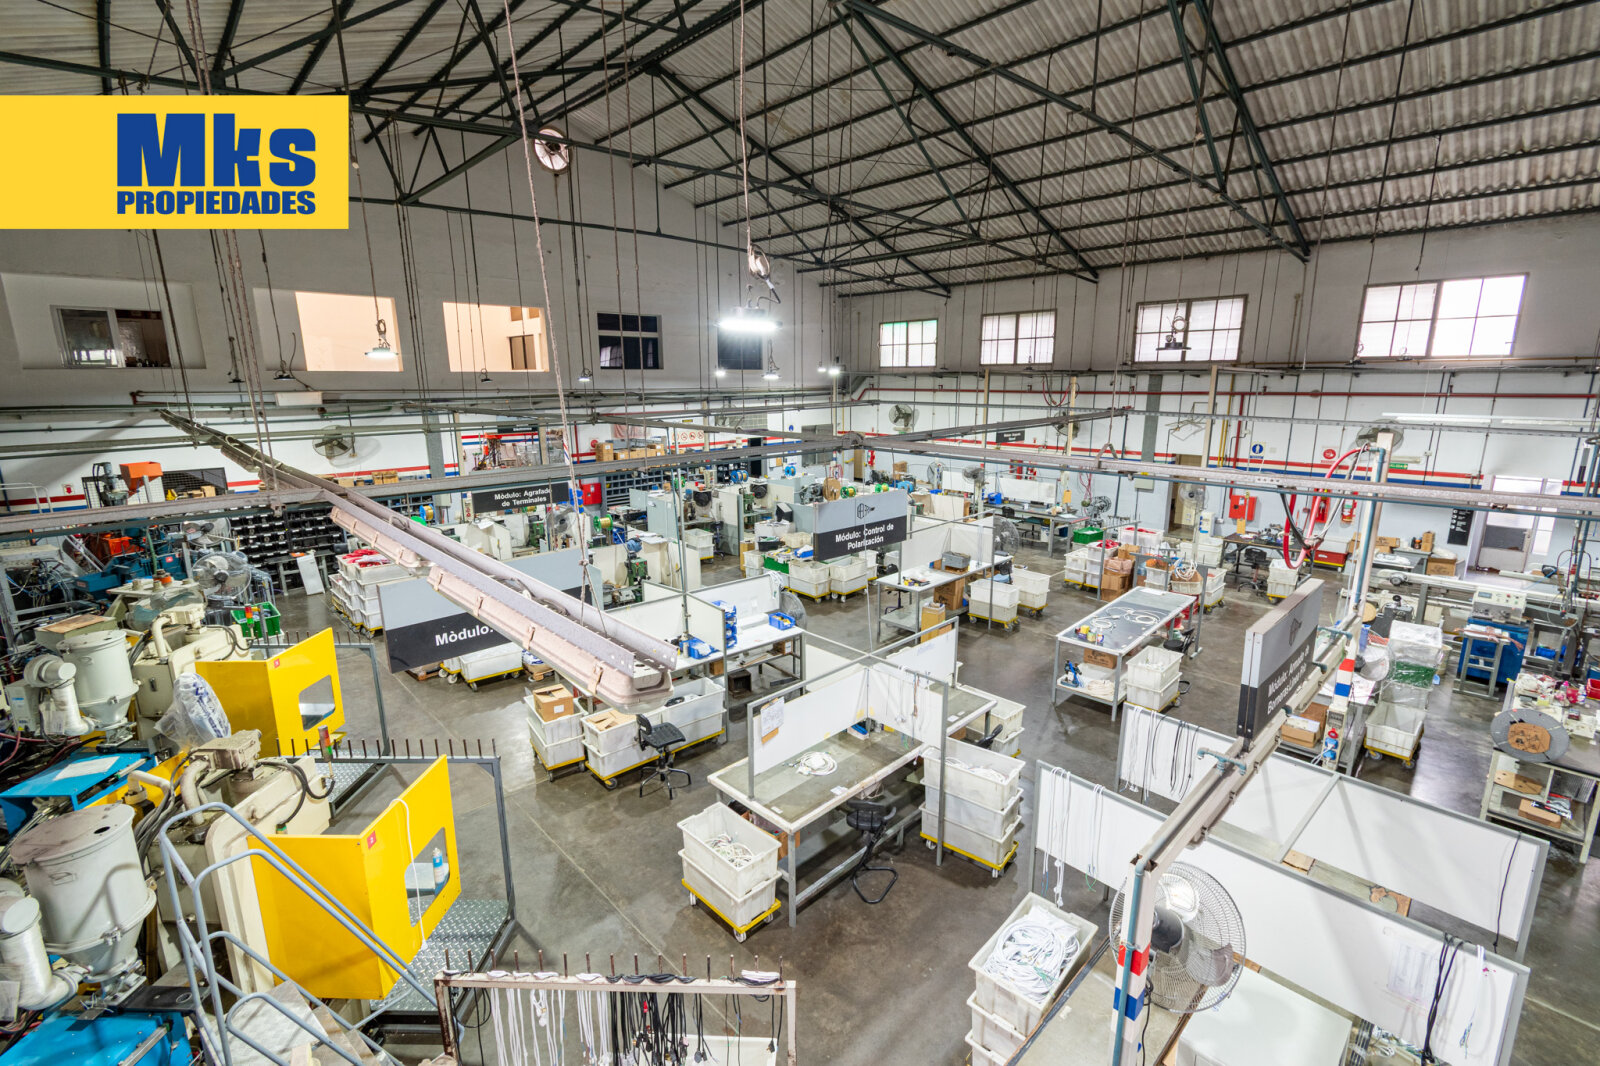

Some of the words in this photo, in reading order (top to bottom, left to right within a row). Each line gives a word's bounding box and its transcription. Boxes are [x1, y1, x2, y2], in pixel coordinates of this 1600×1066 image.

[512, 496, 547, 506] Terminales
[863, 525, 885, 535] Control
[886, 523, 894, 531] de
